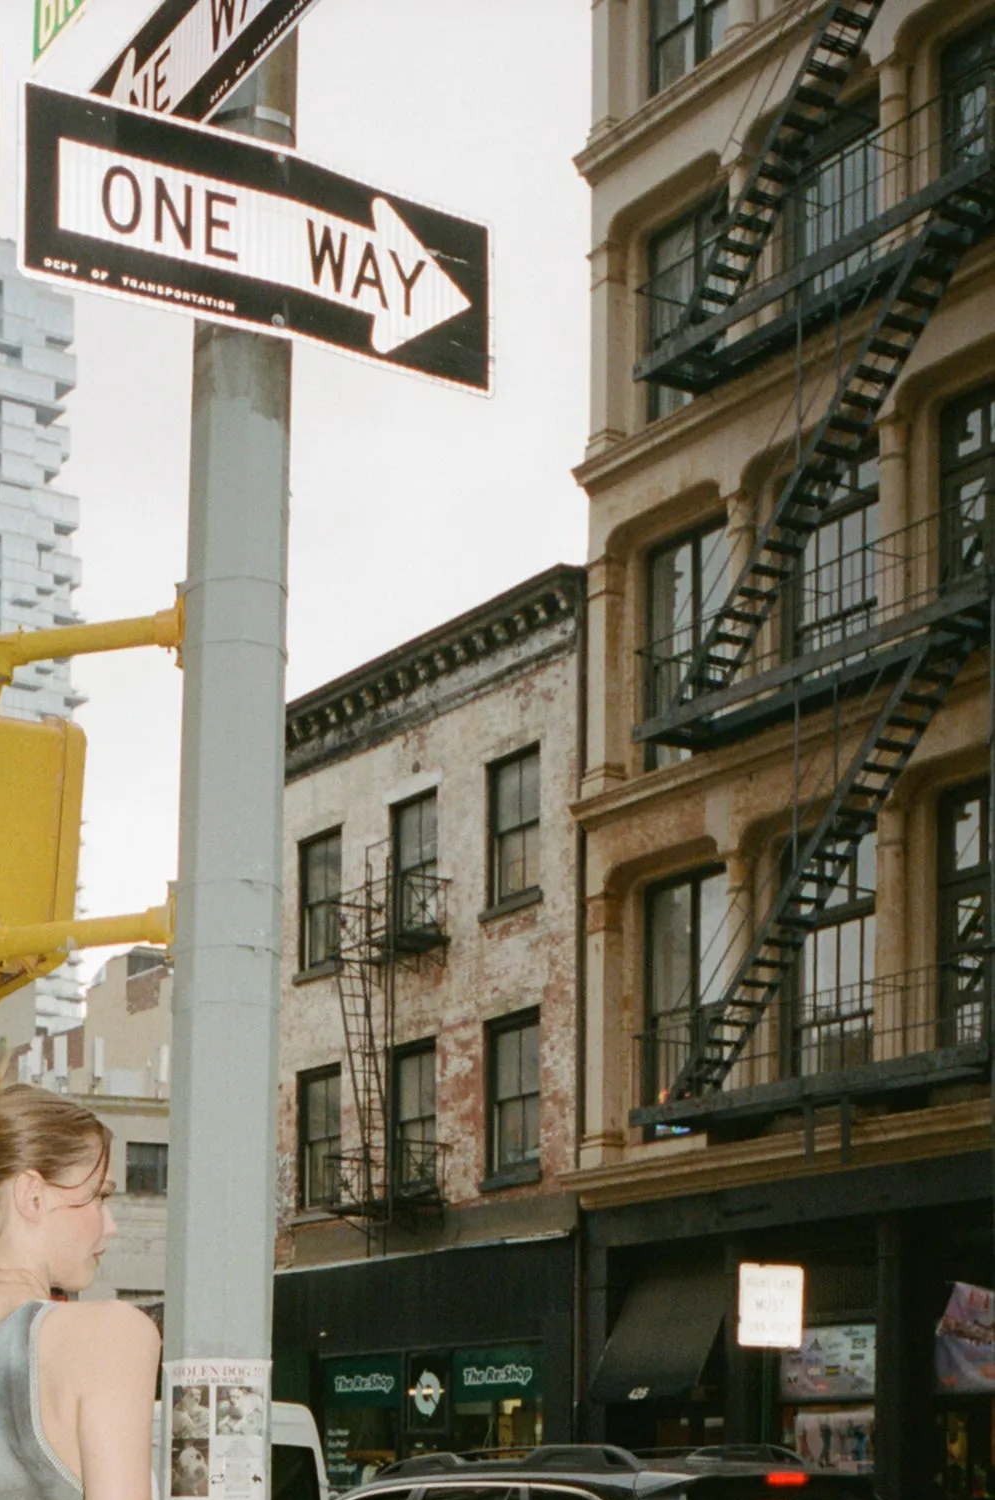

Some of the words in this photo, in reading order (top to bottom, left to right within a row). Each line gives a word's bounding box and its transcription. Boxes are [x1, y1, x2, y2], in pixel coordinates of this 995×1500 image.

[102, 164, 239, 263] ONE
[307, 217, 427, 318] WAY
[43, 256, 78, 274] DEPT
[90, 268, 109, 281] OF
[121, 275, 236, 313] TRANSPORTATION
[334, 1375, 355, 1392] The
[355, 1372, 395, 1394] Re:Shop
[463, 1366, 485, 1386] The
[485, 1363, 533, 1386] Re:Shop
